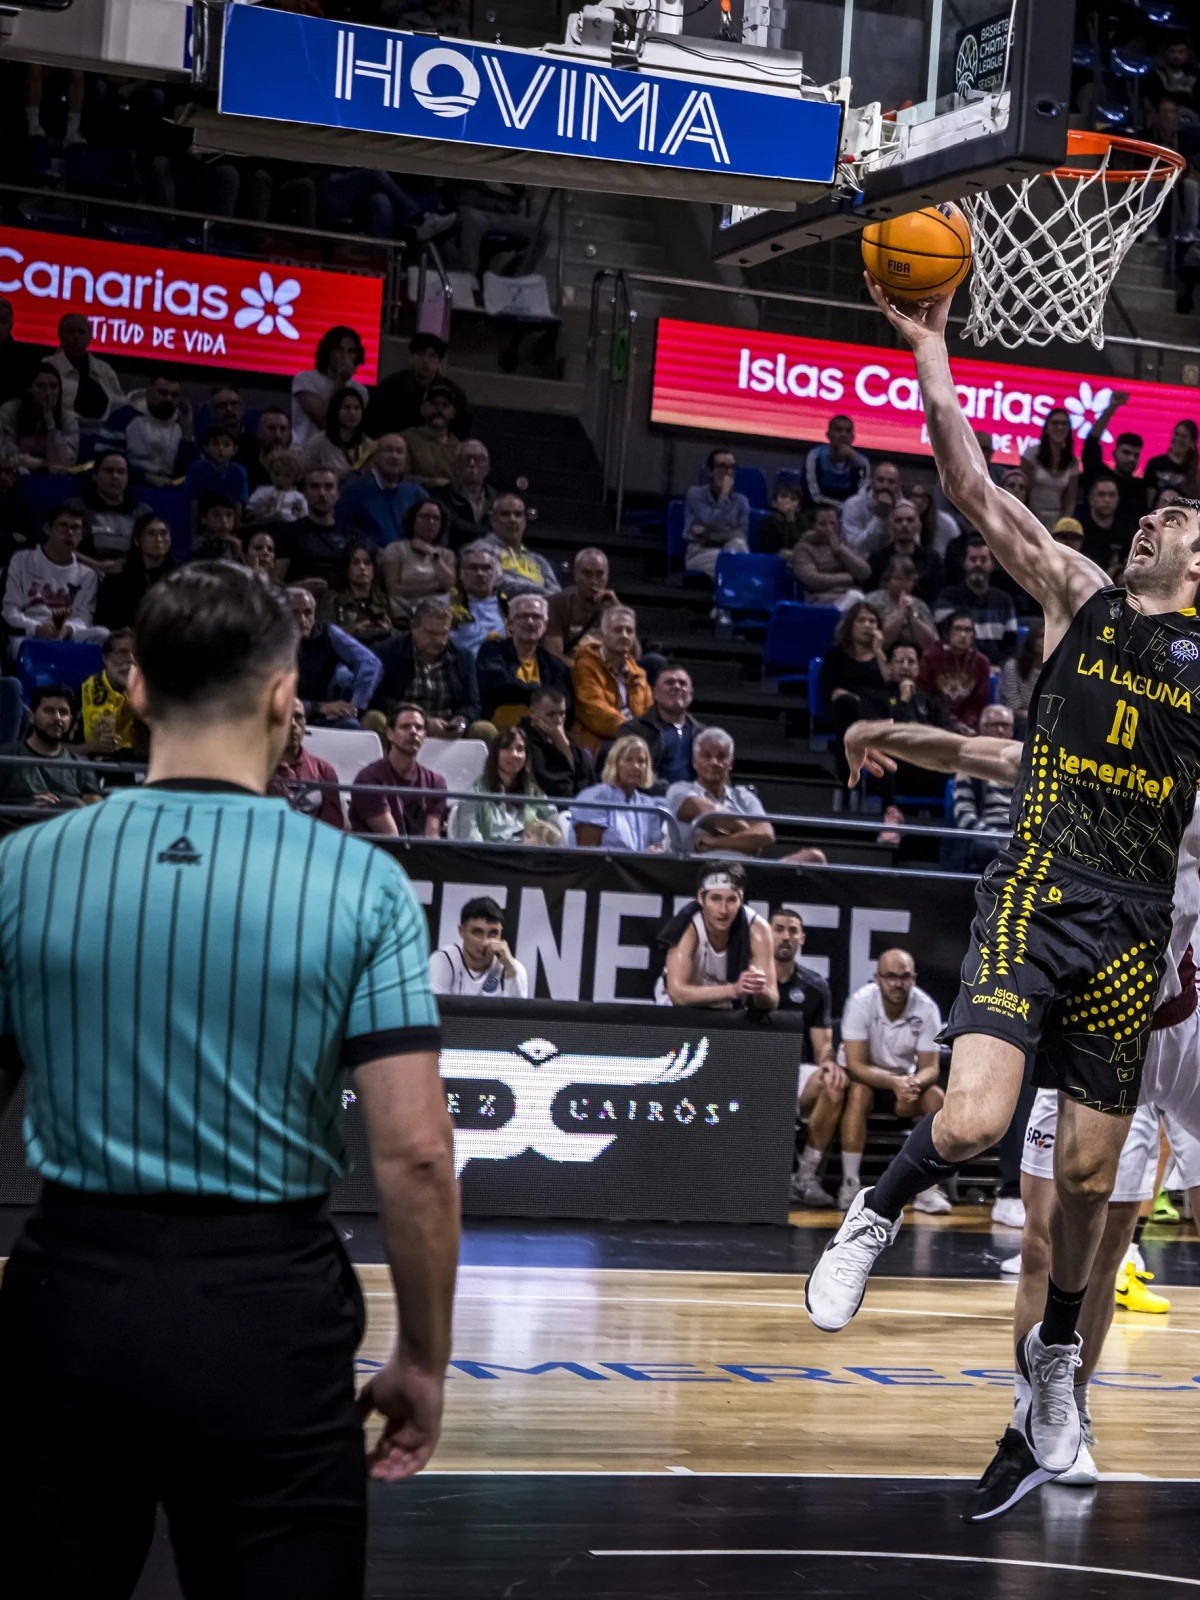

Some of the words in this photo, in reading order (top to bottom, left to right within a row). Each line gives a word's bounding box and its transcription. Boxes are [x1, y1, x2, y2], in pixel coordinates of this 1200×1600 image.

[979, 53, 1004, 74] LEAGUE
[335, 30, 730, 165] HOVIMA
[0, 246, 229, 320] Canarias
[887, 259, 911, 274] FIBA
[88, 316, 144, 345] TITUD
[152, 326, 176, 349] DE
[184, 330, 226, 355] VIDA
[738, 348, 844, 401] Islas
[855, 365, 1055, 427] Caarias
[1076, 653, 1104, 680] LA
[1109, 664, 1192, 714] LAGUNA
[1106, 699, 1140, 750] 19
[994, 986, 1019, 1003] Islas
